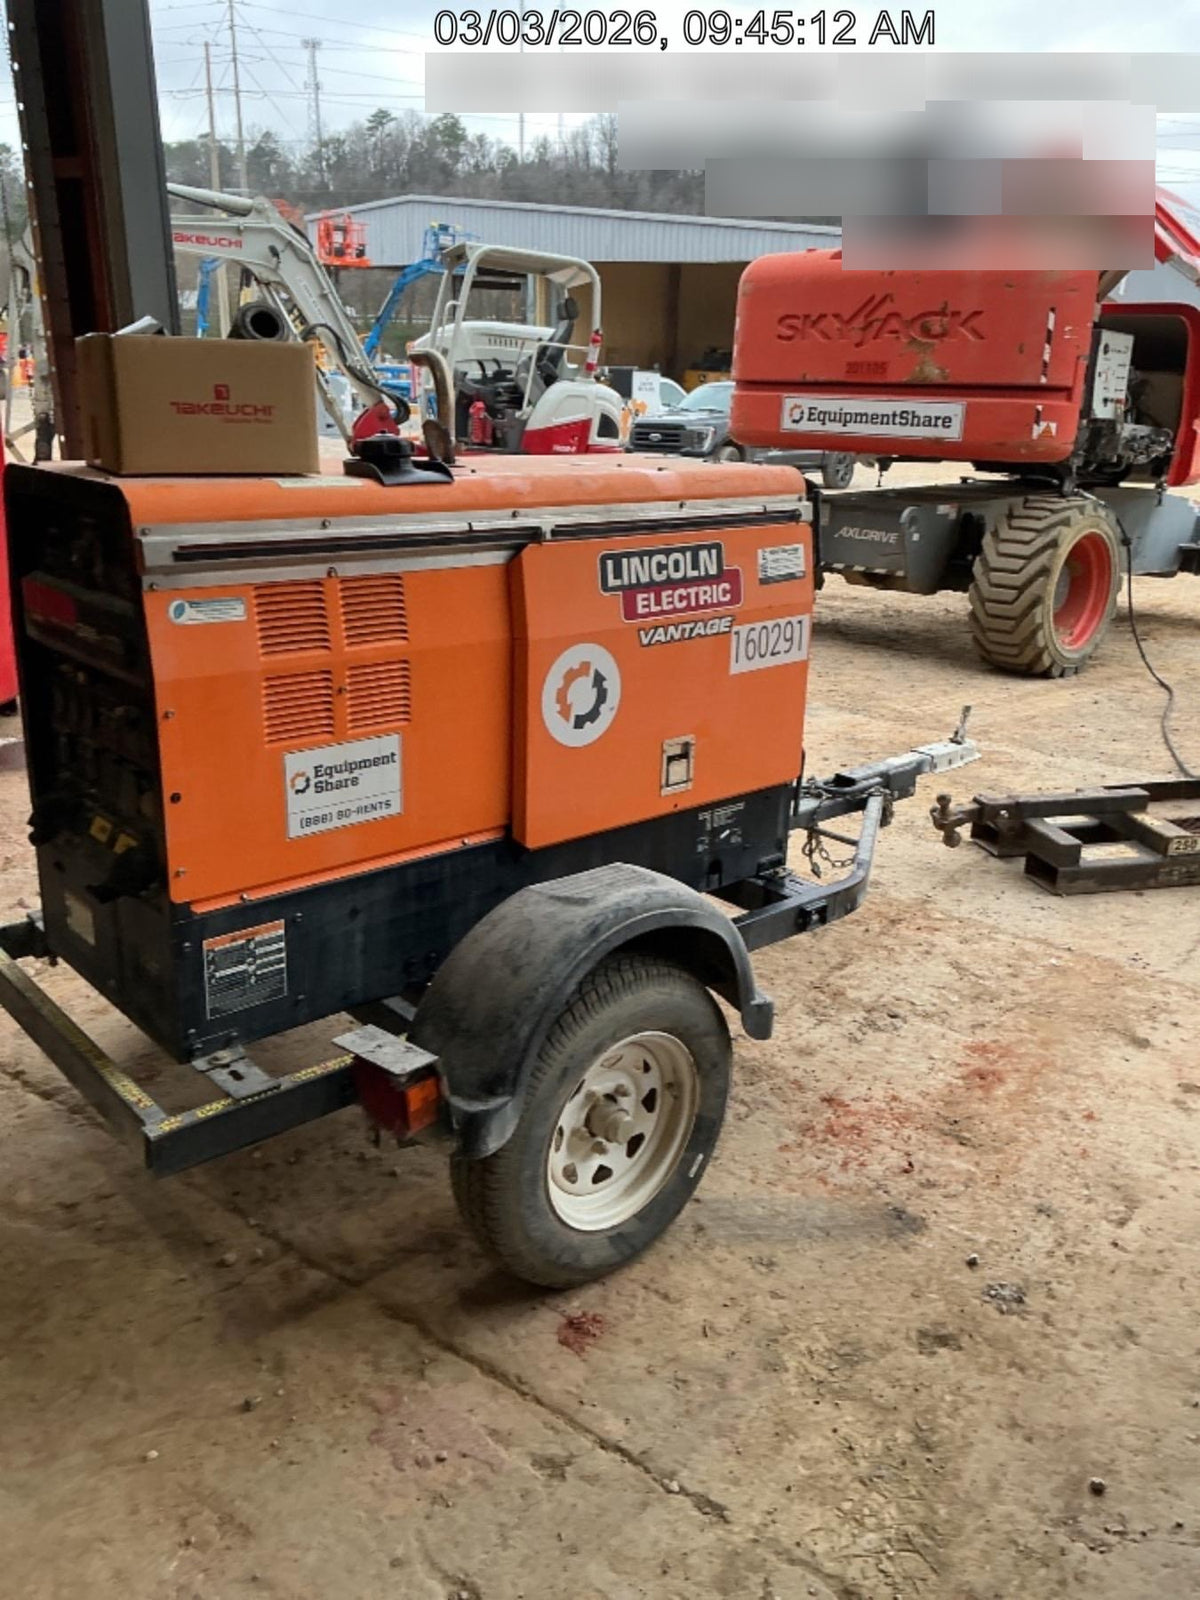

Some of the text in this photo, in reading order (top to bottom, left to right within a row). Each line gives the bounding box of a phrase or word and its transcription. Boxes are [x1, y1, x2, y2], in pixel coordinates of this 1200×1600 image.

[171, 231, 243, 249] AKEUCHI
[776, 293, 986, 349] SKYJACK
[806, 406, 953, 429] EquipmentShare
[833, 525, 899, 544] AXLDRIVE
[606, 549, 718, 588] LINCOLN
[636, 582, 731, 615] ELECTRIC
[638, 615, 734, 648] VANTAGE
[733, 618, 805, 664] 160291
[313, 751, 397, 779] Equipment
[313, 776, 360, 794] Share
